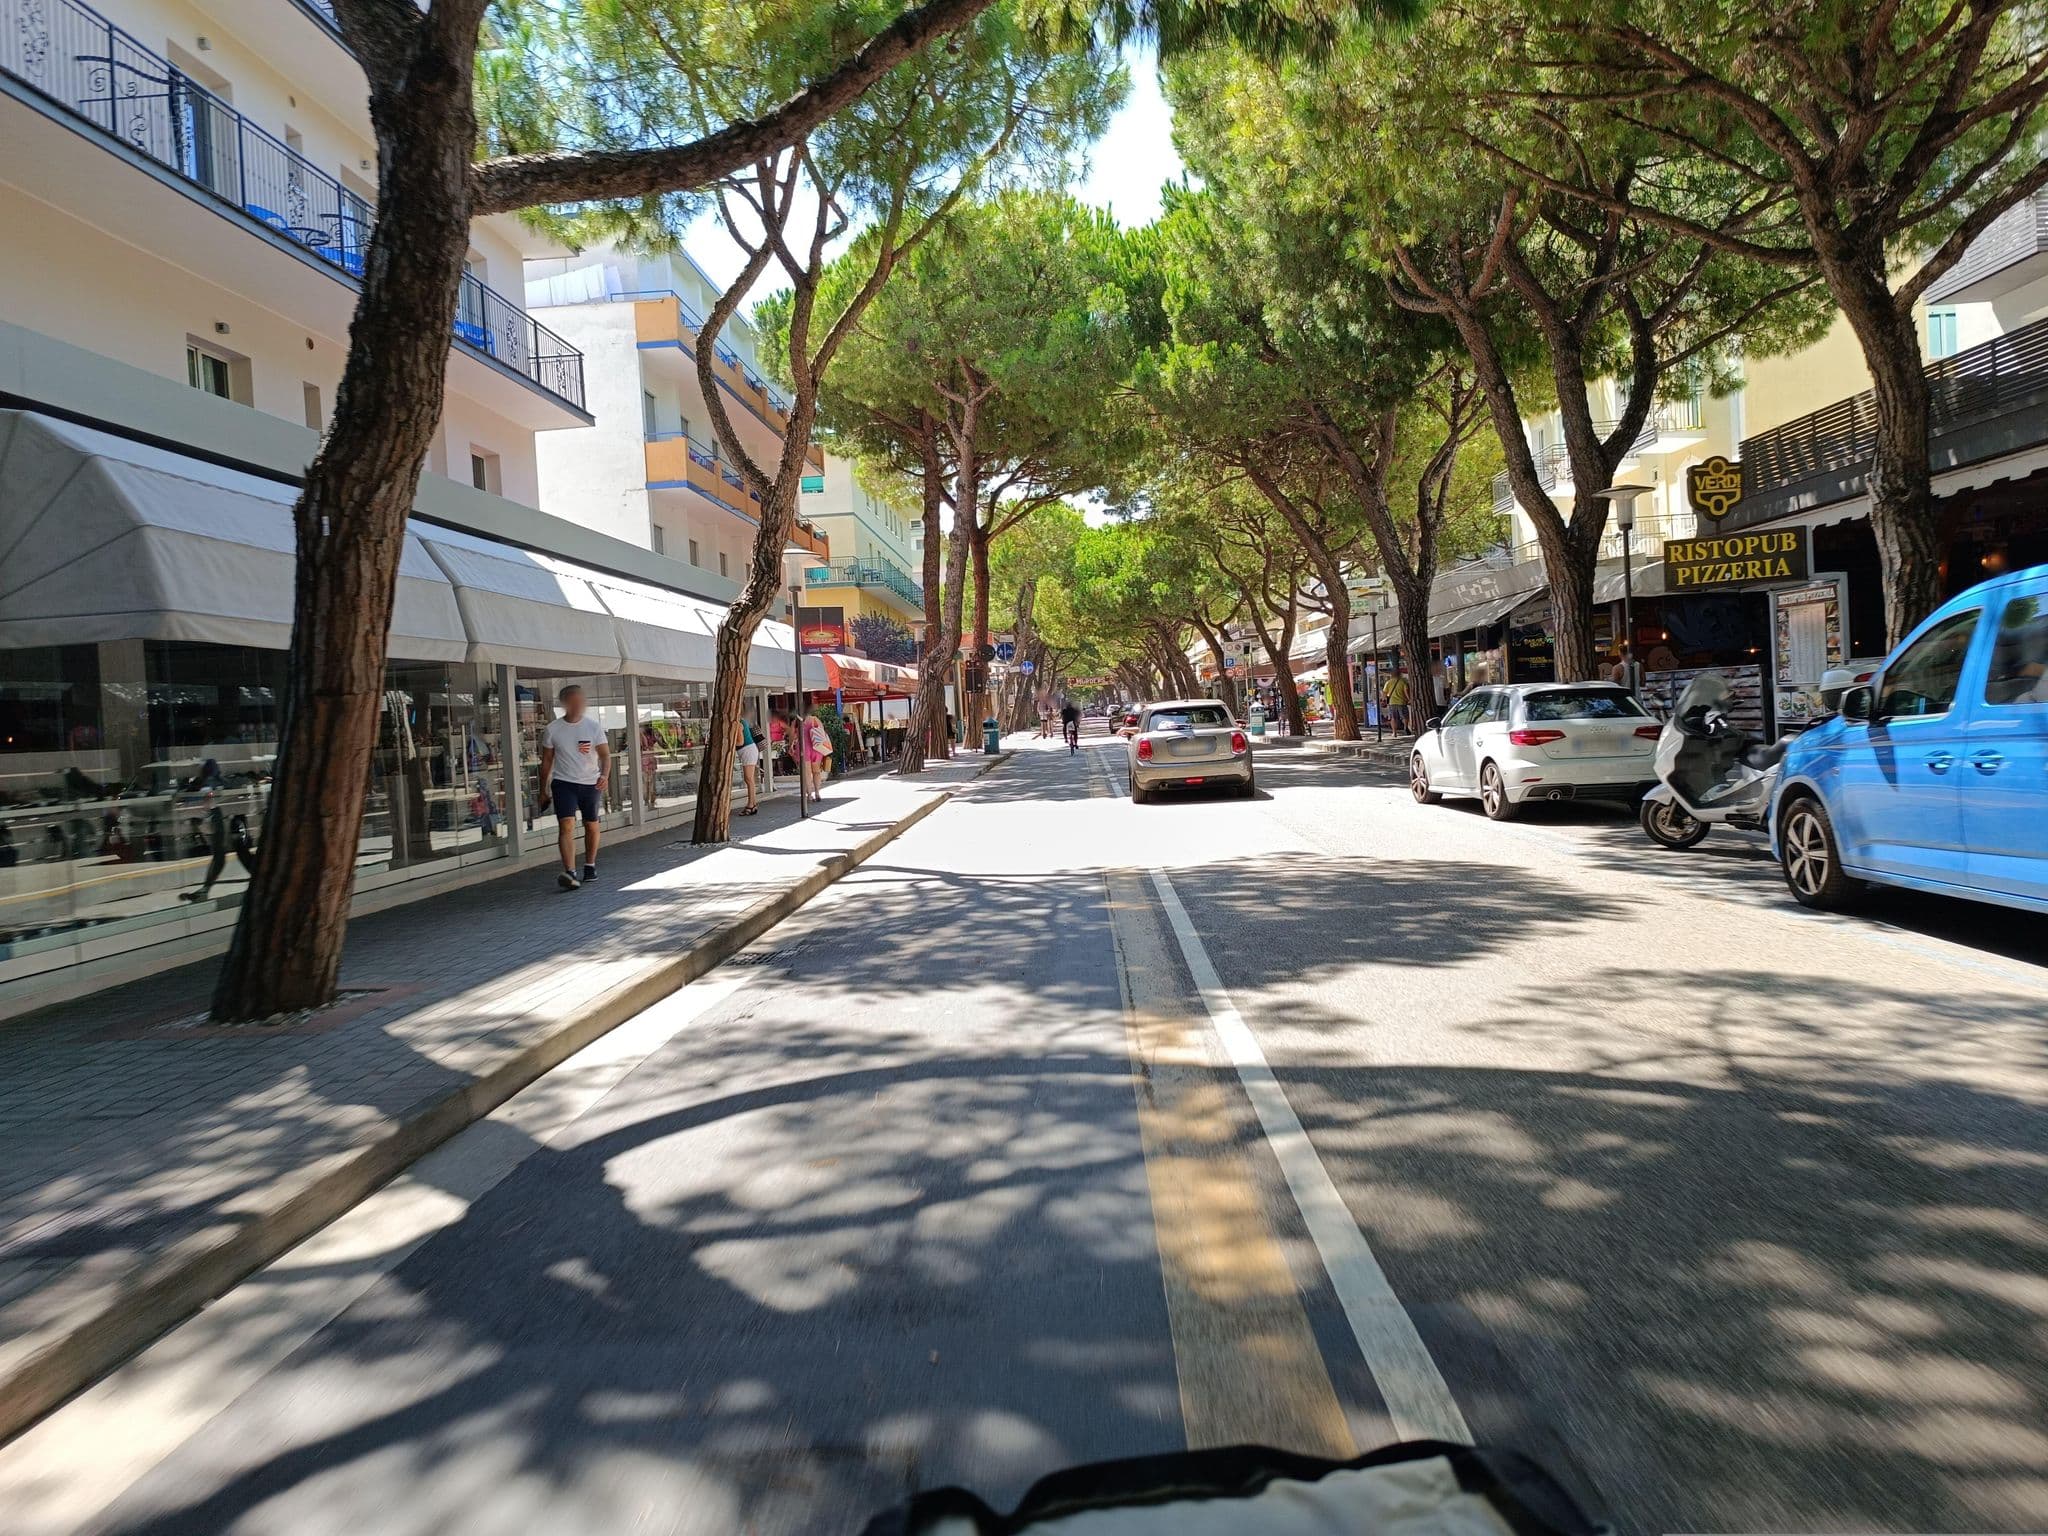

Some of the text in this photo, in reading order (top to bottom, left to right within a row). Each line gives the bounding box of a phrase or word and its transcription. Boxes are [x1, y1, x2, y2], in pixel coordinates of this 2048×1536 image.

[1695, 473, 1741, 490] VERDI
[1668, 532, 1797, 563] RISTOPUB
[1676, 557, 1792, 586] PIZZERIA
